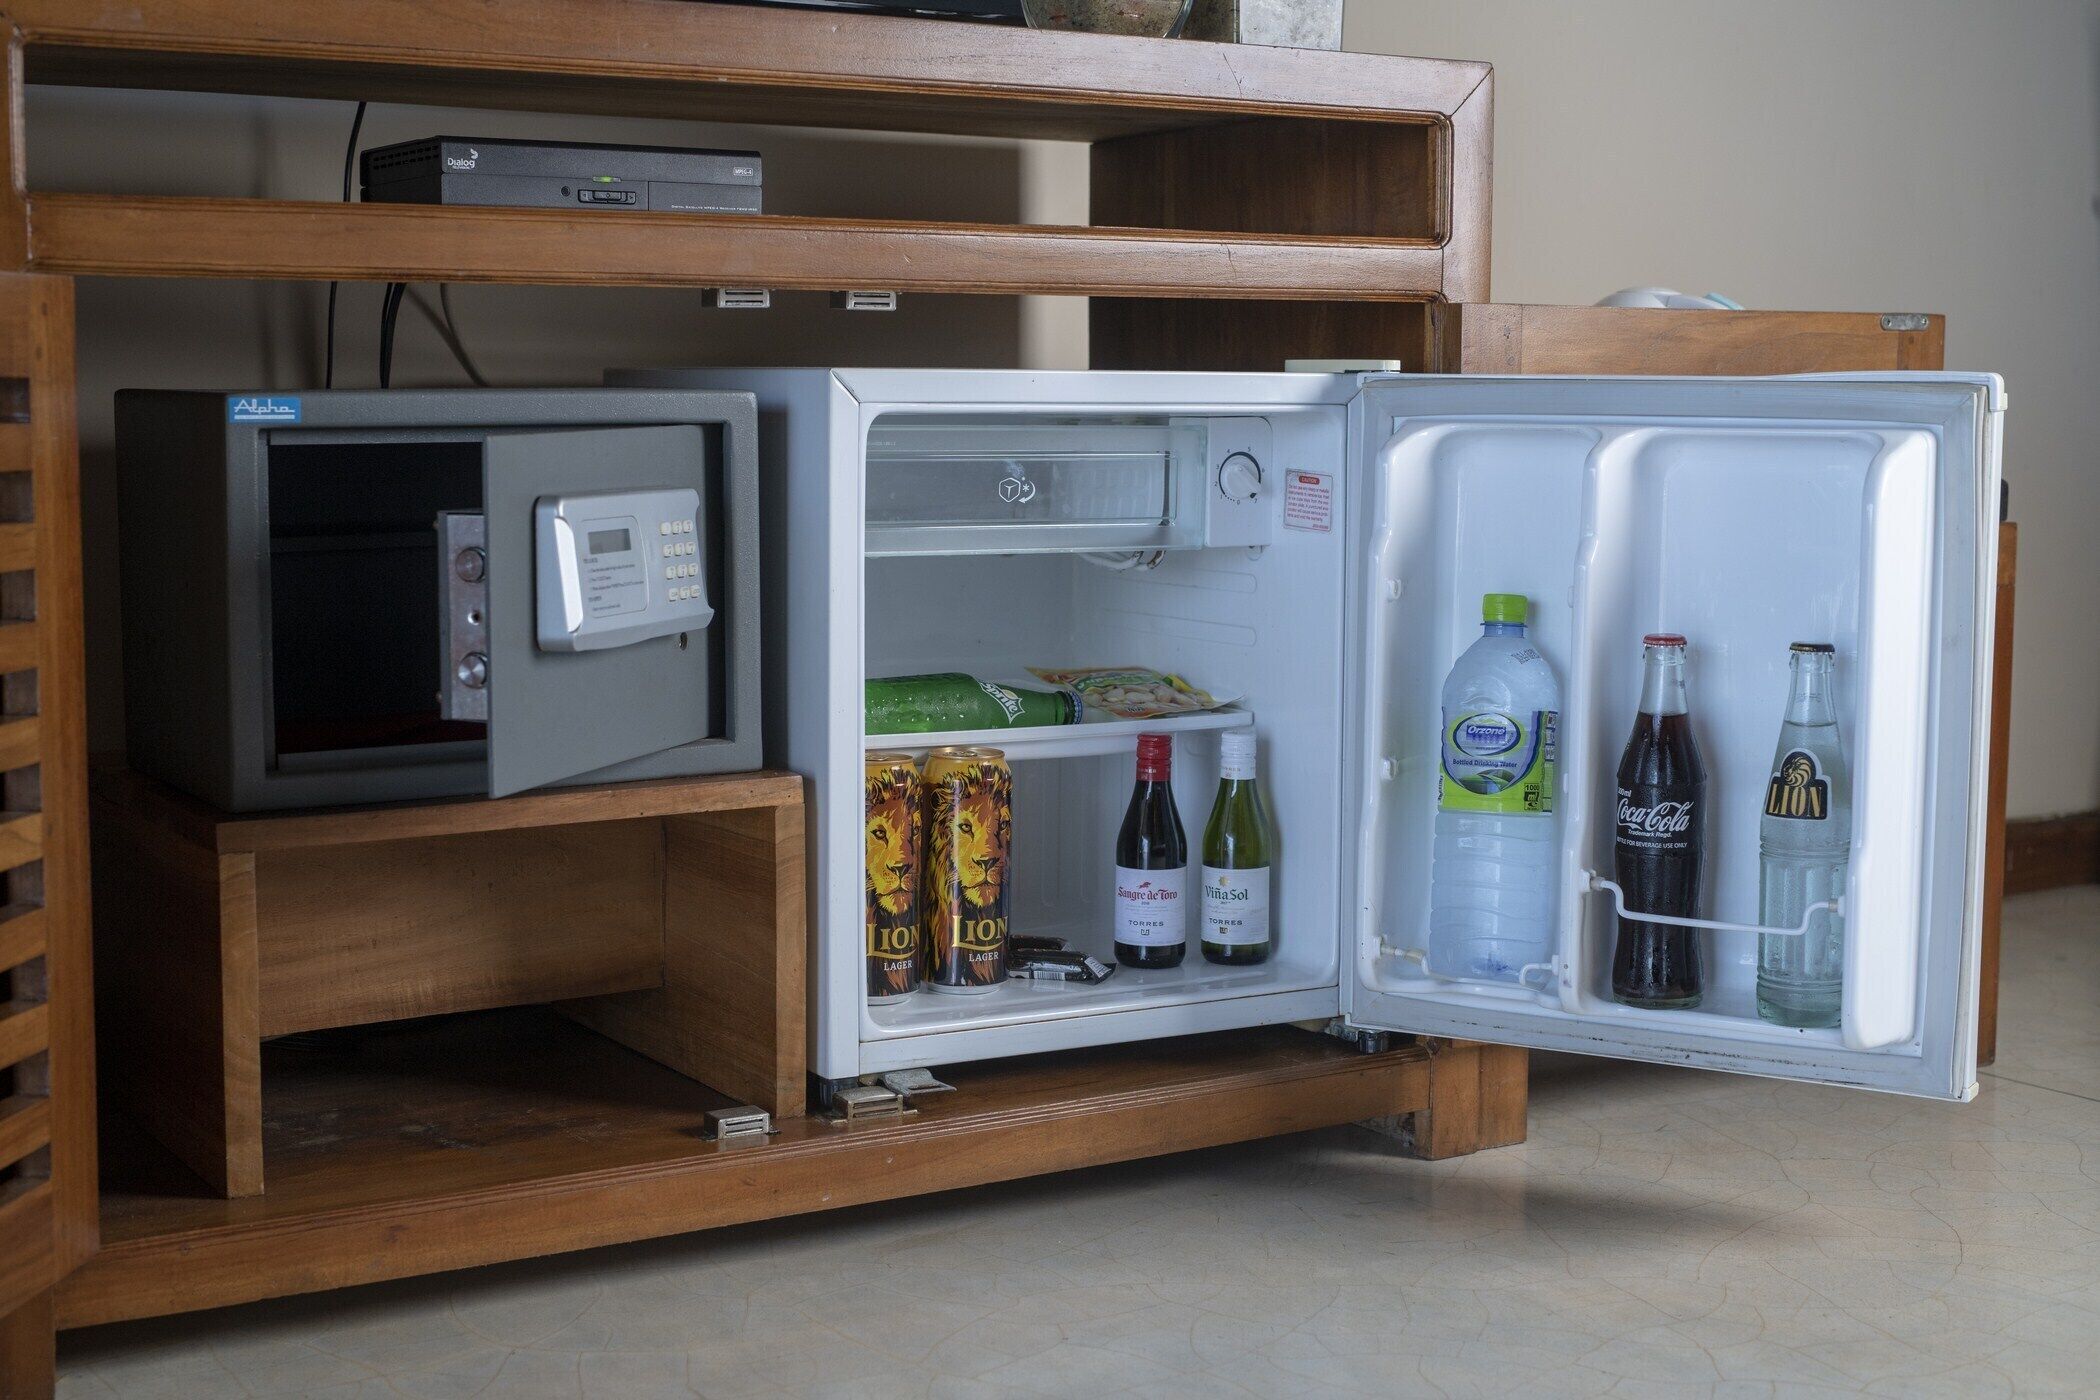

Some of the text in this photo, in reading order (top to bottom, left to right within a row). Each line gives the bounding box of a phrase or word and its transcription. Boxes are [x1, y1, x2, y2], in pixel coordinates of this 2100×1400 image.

[448, 158, 475, 169] Dialog
[234, 399, 295, 414] Alpha
[984, 683, 1018, 713] Sprite
[1468, 726, 1505, 735] Orzone
[1474, 760, 1499, 768] Drinking
[1768, 783, 1824, 817] LION
[1617, 798, 1694, 832] Coca-Cola
[1628, 829, 1655, 837] Trademark
[1118, 886, 1178, 901] Sangre de Toro
[1205, 885, 1249, 900] Viña Sol
[1209, 917, 1243, 925] TORRES
[952, 915, 1008, 948] LION
[866, 923, 920, 957] LION
[968, 952, 999, 962] LAGER
[883, 960, 912, 971] LAGER
